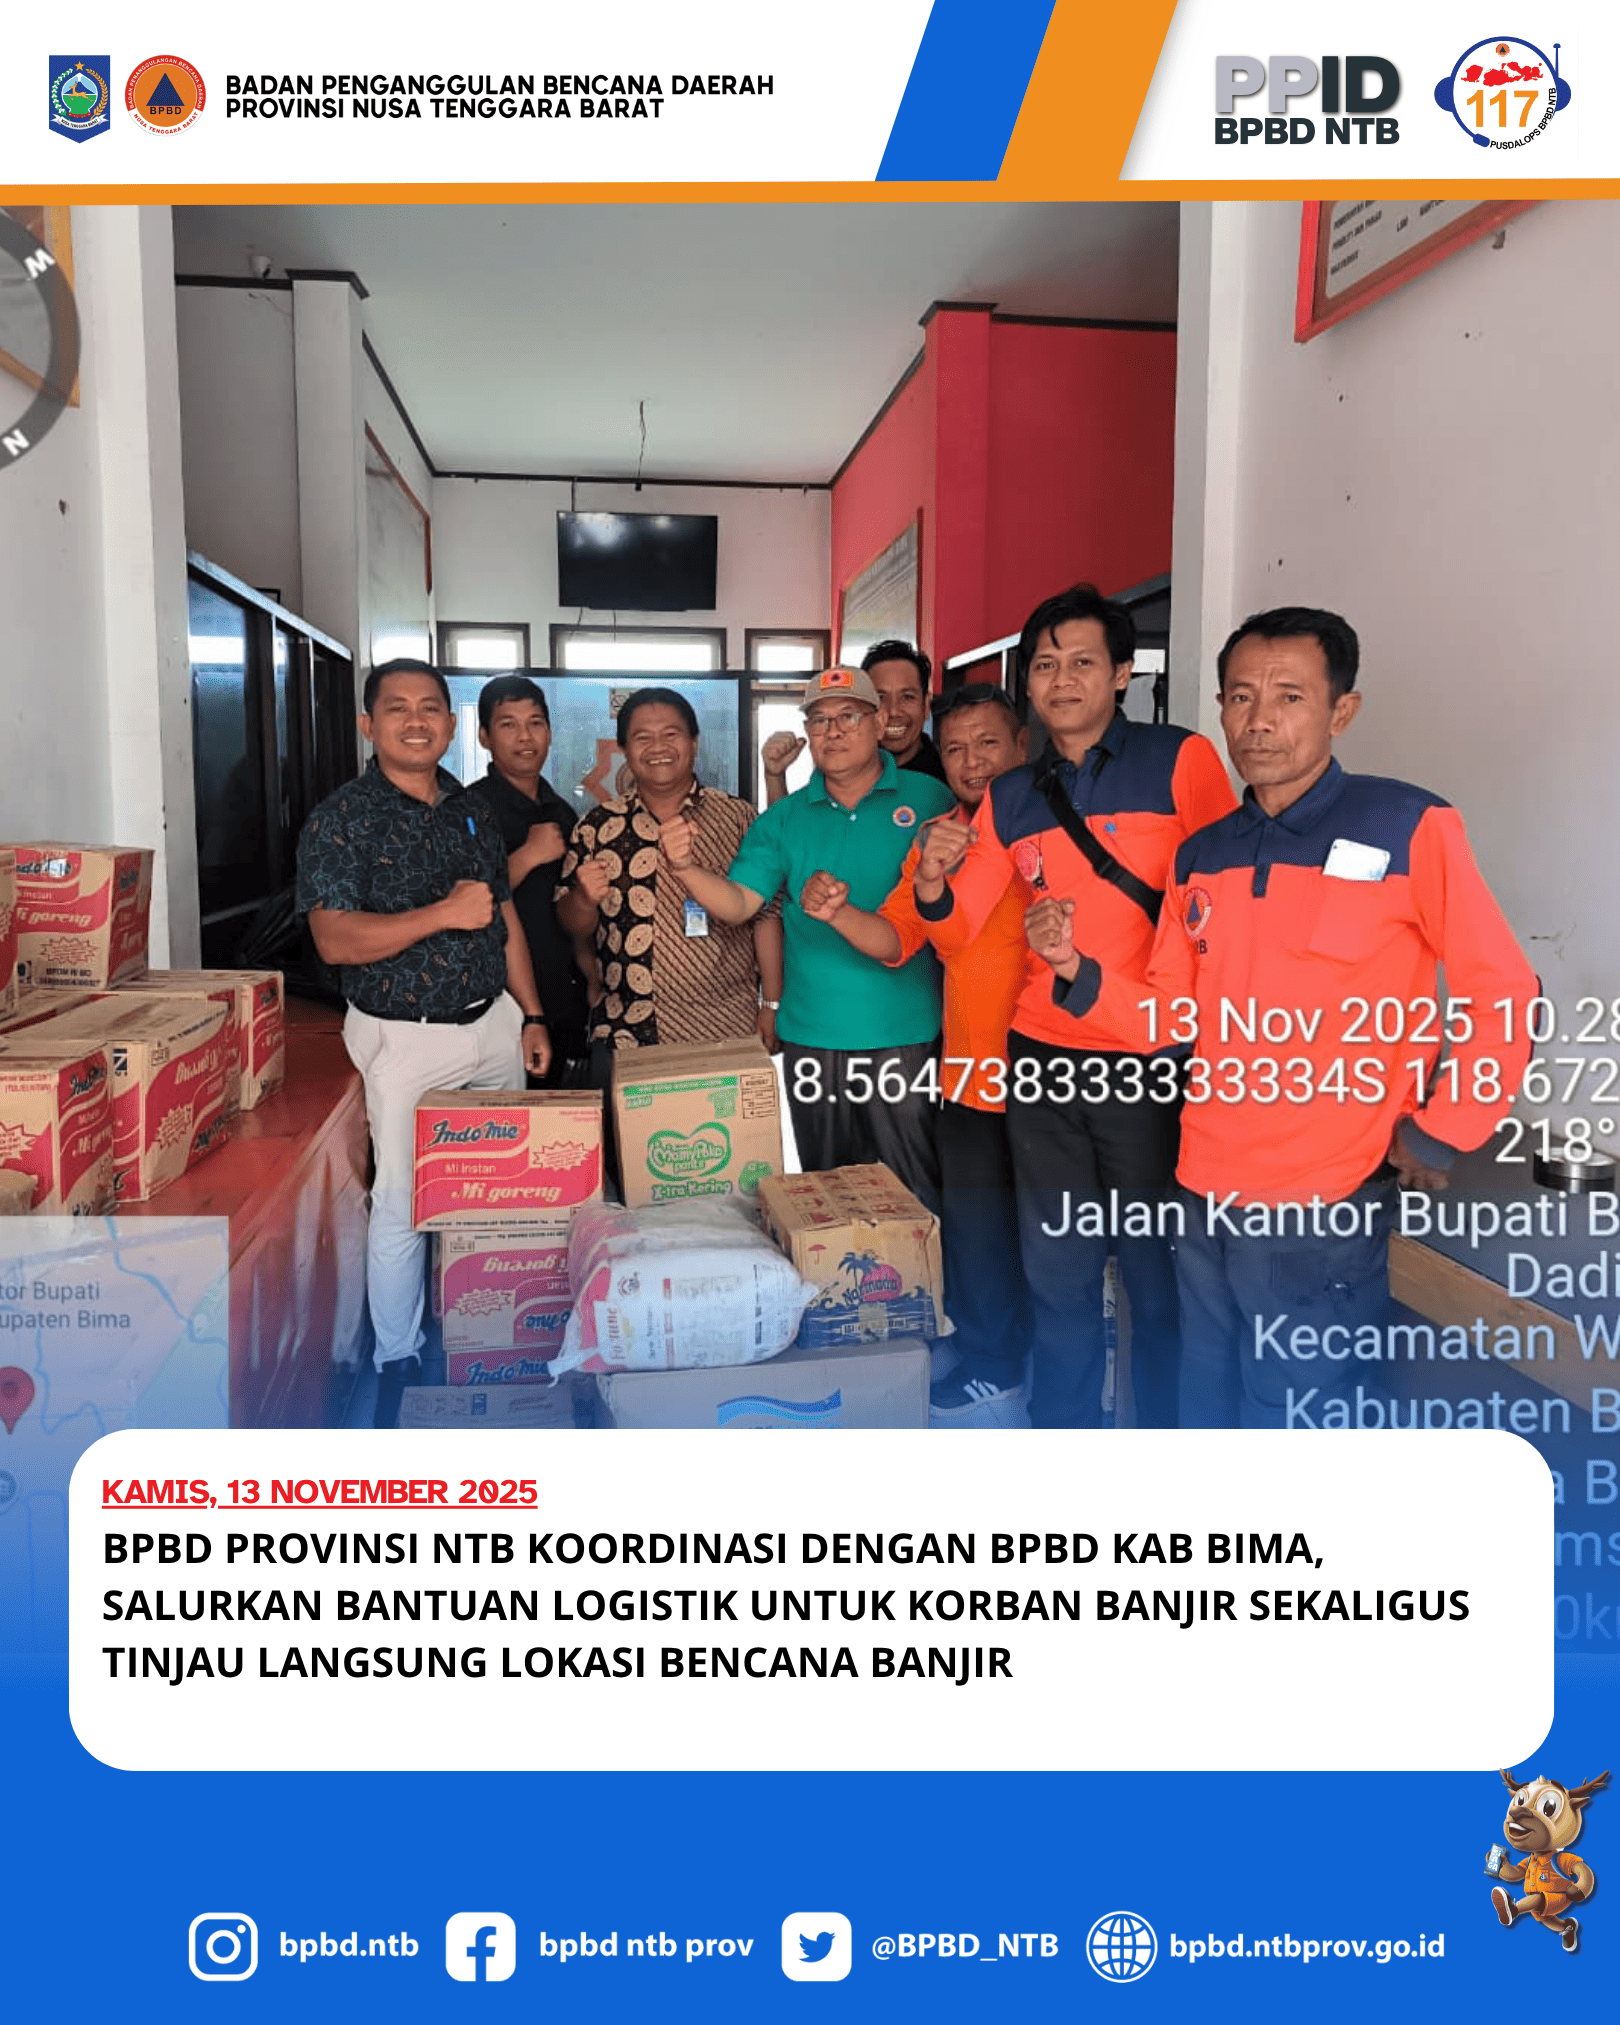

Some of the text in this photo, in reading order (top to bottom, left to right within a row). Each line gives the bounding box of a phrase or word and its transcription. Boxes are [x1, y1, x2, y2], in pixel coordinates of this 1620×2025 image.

[461, 1162, 497, 1174] Instan
[486, 1185, 563, 1204] goreng
[687, 1178, 733, 1197] Kering
